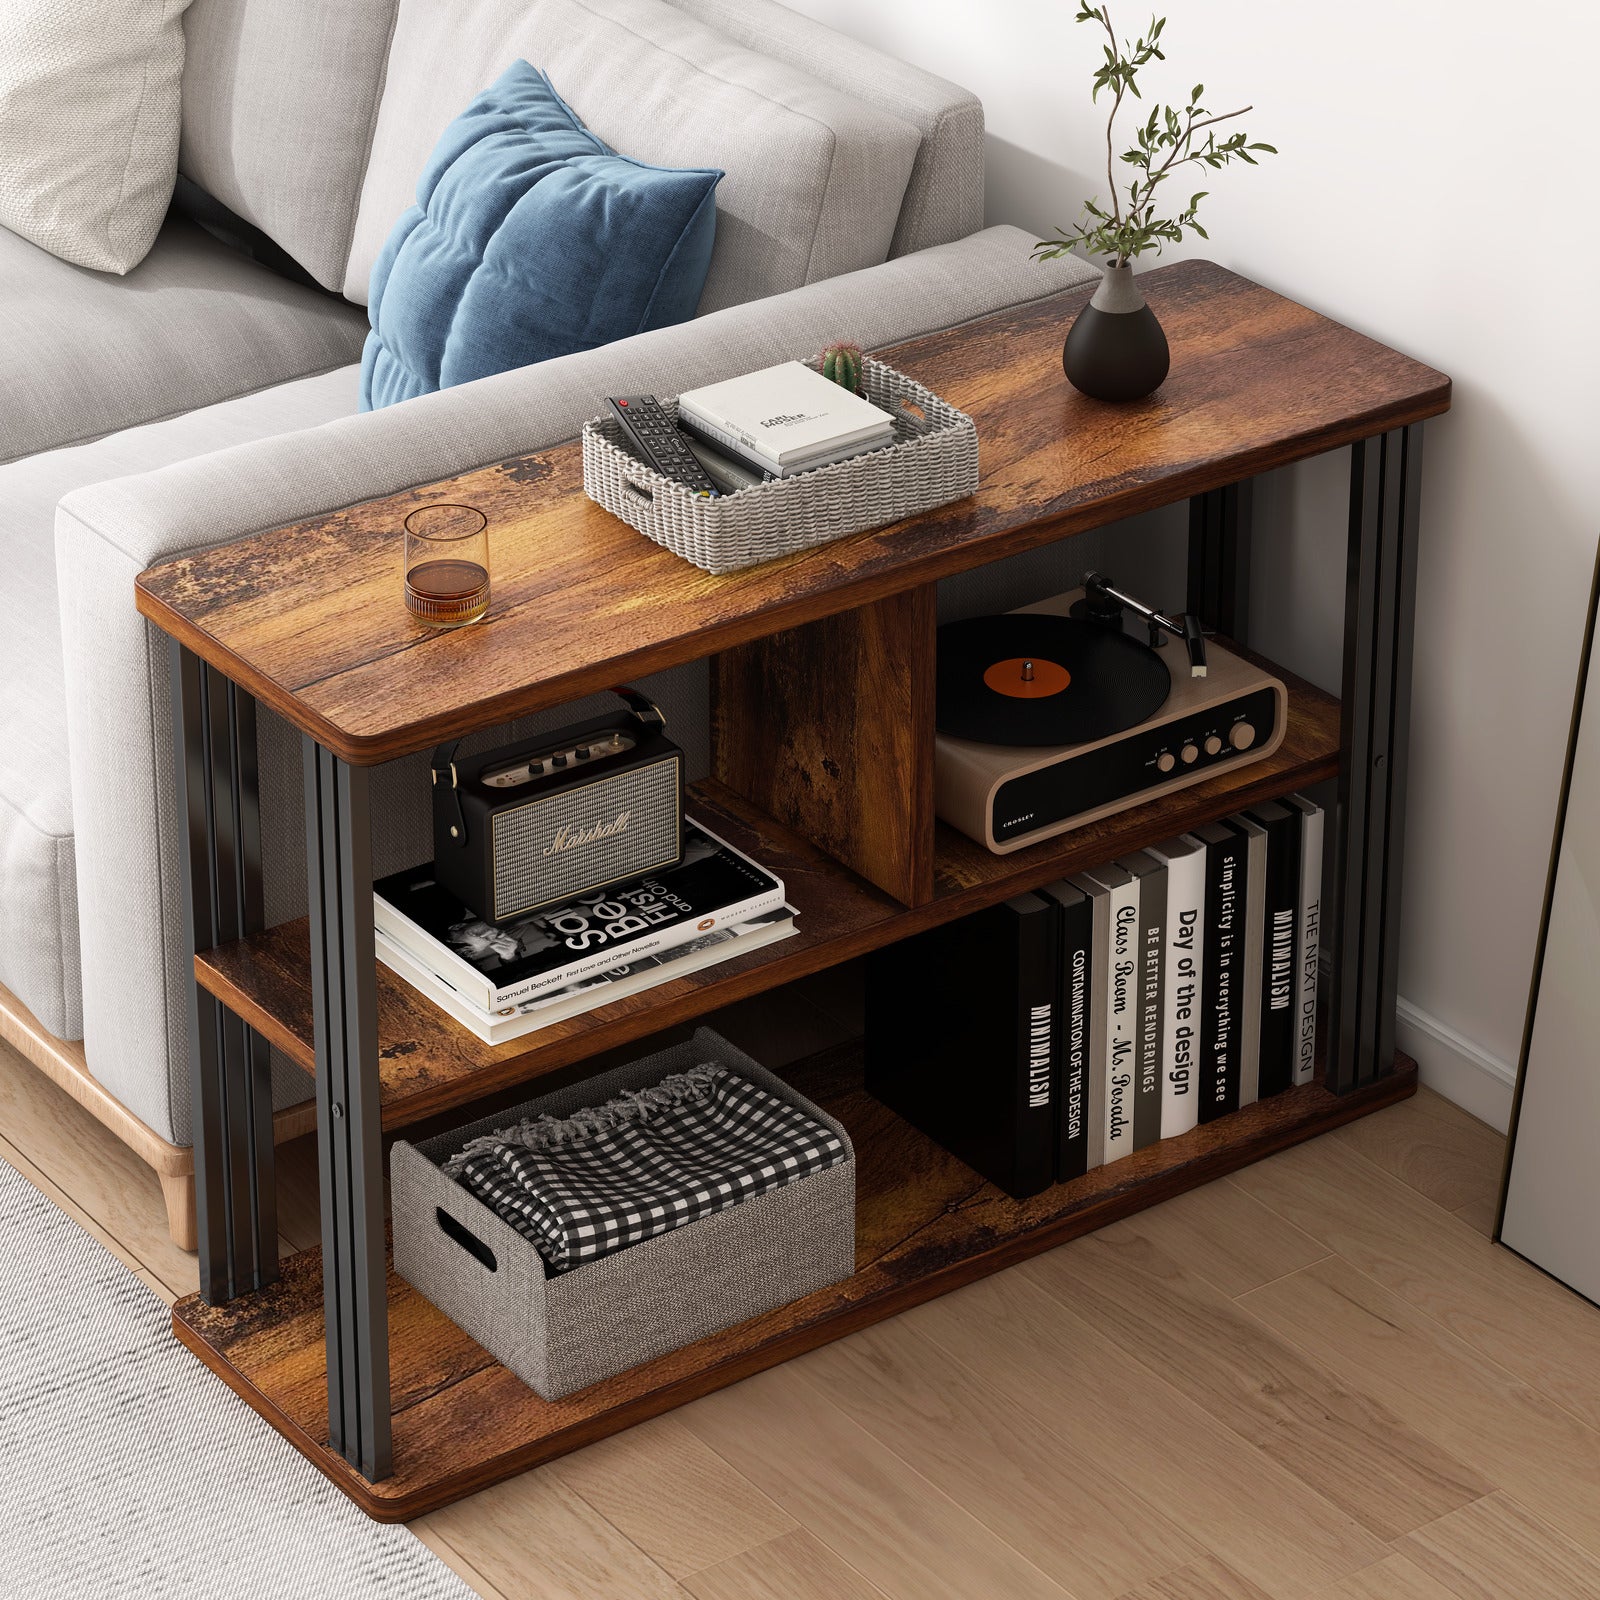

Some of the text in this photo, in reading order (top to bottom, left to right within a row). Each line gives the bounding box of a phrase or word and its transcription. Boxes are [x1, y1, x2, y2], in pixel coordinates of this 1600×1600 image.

[543, 810, 631, 857] Marshall
[1003, 812, 1034, 828] CROSLEY
[616, 888, 679, 925] First
[660, 893, 692, 912] and
[1115, 905, 1136, 955] Class
[496, 940, 661, 1003] Samuel Beckett First Love and Other Novellas
[1113, 960, 1134, 1015] Room
[1214, 856, 1236, 1101] simplicity is in everything we see
[1270, 909, 1293, 1010] MINIMALISM
[1301, 899, 1319, 1073] THE NEXT DESIGN
[1142, 927, 1159, 1093] BE BETTER RENDERINGS
[1169, 909, 1197, 1096] Day of the design
[1029, 1004, 1051, 1108] MINIMALISM
[1068, 950, 1085, 1140] CONTAMINATION OF THE DESIGN
[1111, 1036, 1131, 1071] Ms.
[1109, 1073, 1130, 1141] Posada
